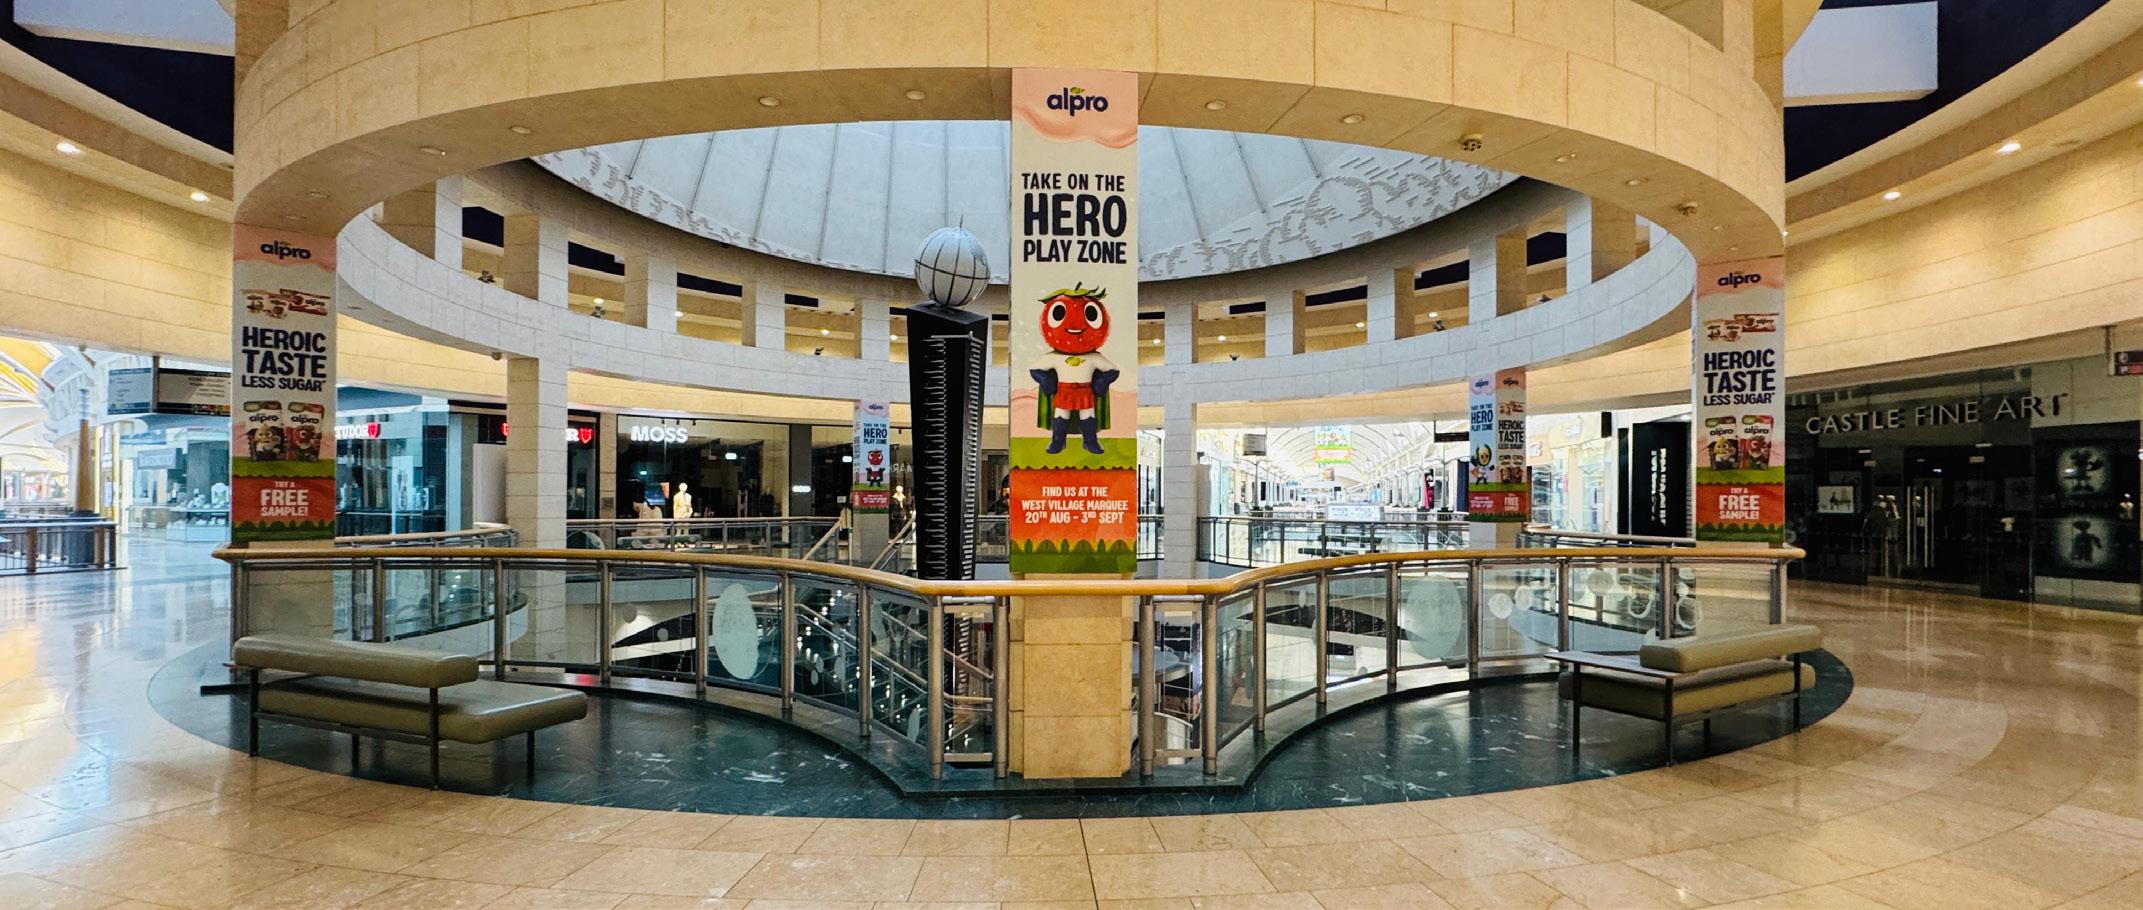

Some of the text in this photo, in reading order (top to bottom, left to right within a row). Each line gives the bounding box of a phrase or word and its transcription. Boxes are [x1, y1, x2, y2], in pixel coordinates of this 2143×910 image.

[1047, 87, 1109, 116] alpro
[1021, 173, 1125, 192] TAKE ON THE
[1023, 192, 1127, 238] HERO
[260, 240, 311, 260] alpro
[1023, 239, 1127, 264] PLAY ZONE
[1717, 272, 1761, 288] alpro
[242, 326, 326, 354] HEROIC
[241, 349, 327, 379] TASTE
[1703, 348, 1775, 372] HEROIC
[241, 375, 276, 389] LESS
[1703, 368, 1776, 394] TASTE
[1703, 394, 1731, 407] LESS
[249, 413, 279, 423] alpro
[290, 414, 320, 425] alpro
[1471, 409, 1494, 424] HERO
[1805, 393, 2070, 435] CASTLE FINE ART
[1498, 419, 1524, 430] HEROIC
[1709, 427, 1734, 436] alpro
[1744, 426, 1769, 435] alpro
[630, 425, 689, 444] MOSS
[863, 428, 888, 439] HERO
[1498, 431, 1525, 443] TASTE
[260, 489, 309, 506] FREE
[1042, 486, 1108, 497] FIND US AT THE
[1021, 500, 1128, 510] WEST VILLAGE MARQUEE
[1718, 495, 1760, 511] FREE
[260, 506, 309, 517] SAMPLE!
[1025, 511, 1047, 524] 20TH
[1049, 511, 1071, 524] AUG
[1081, 511, 1097, 524] 3RD
[1098, 511, 1125, 524] SEPT
[1719, 510, 1760, 520] SAMPLE!
